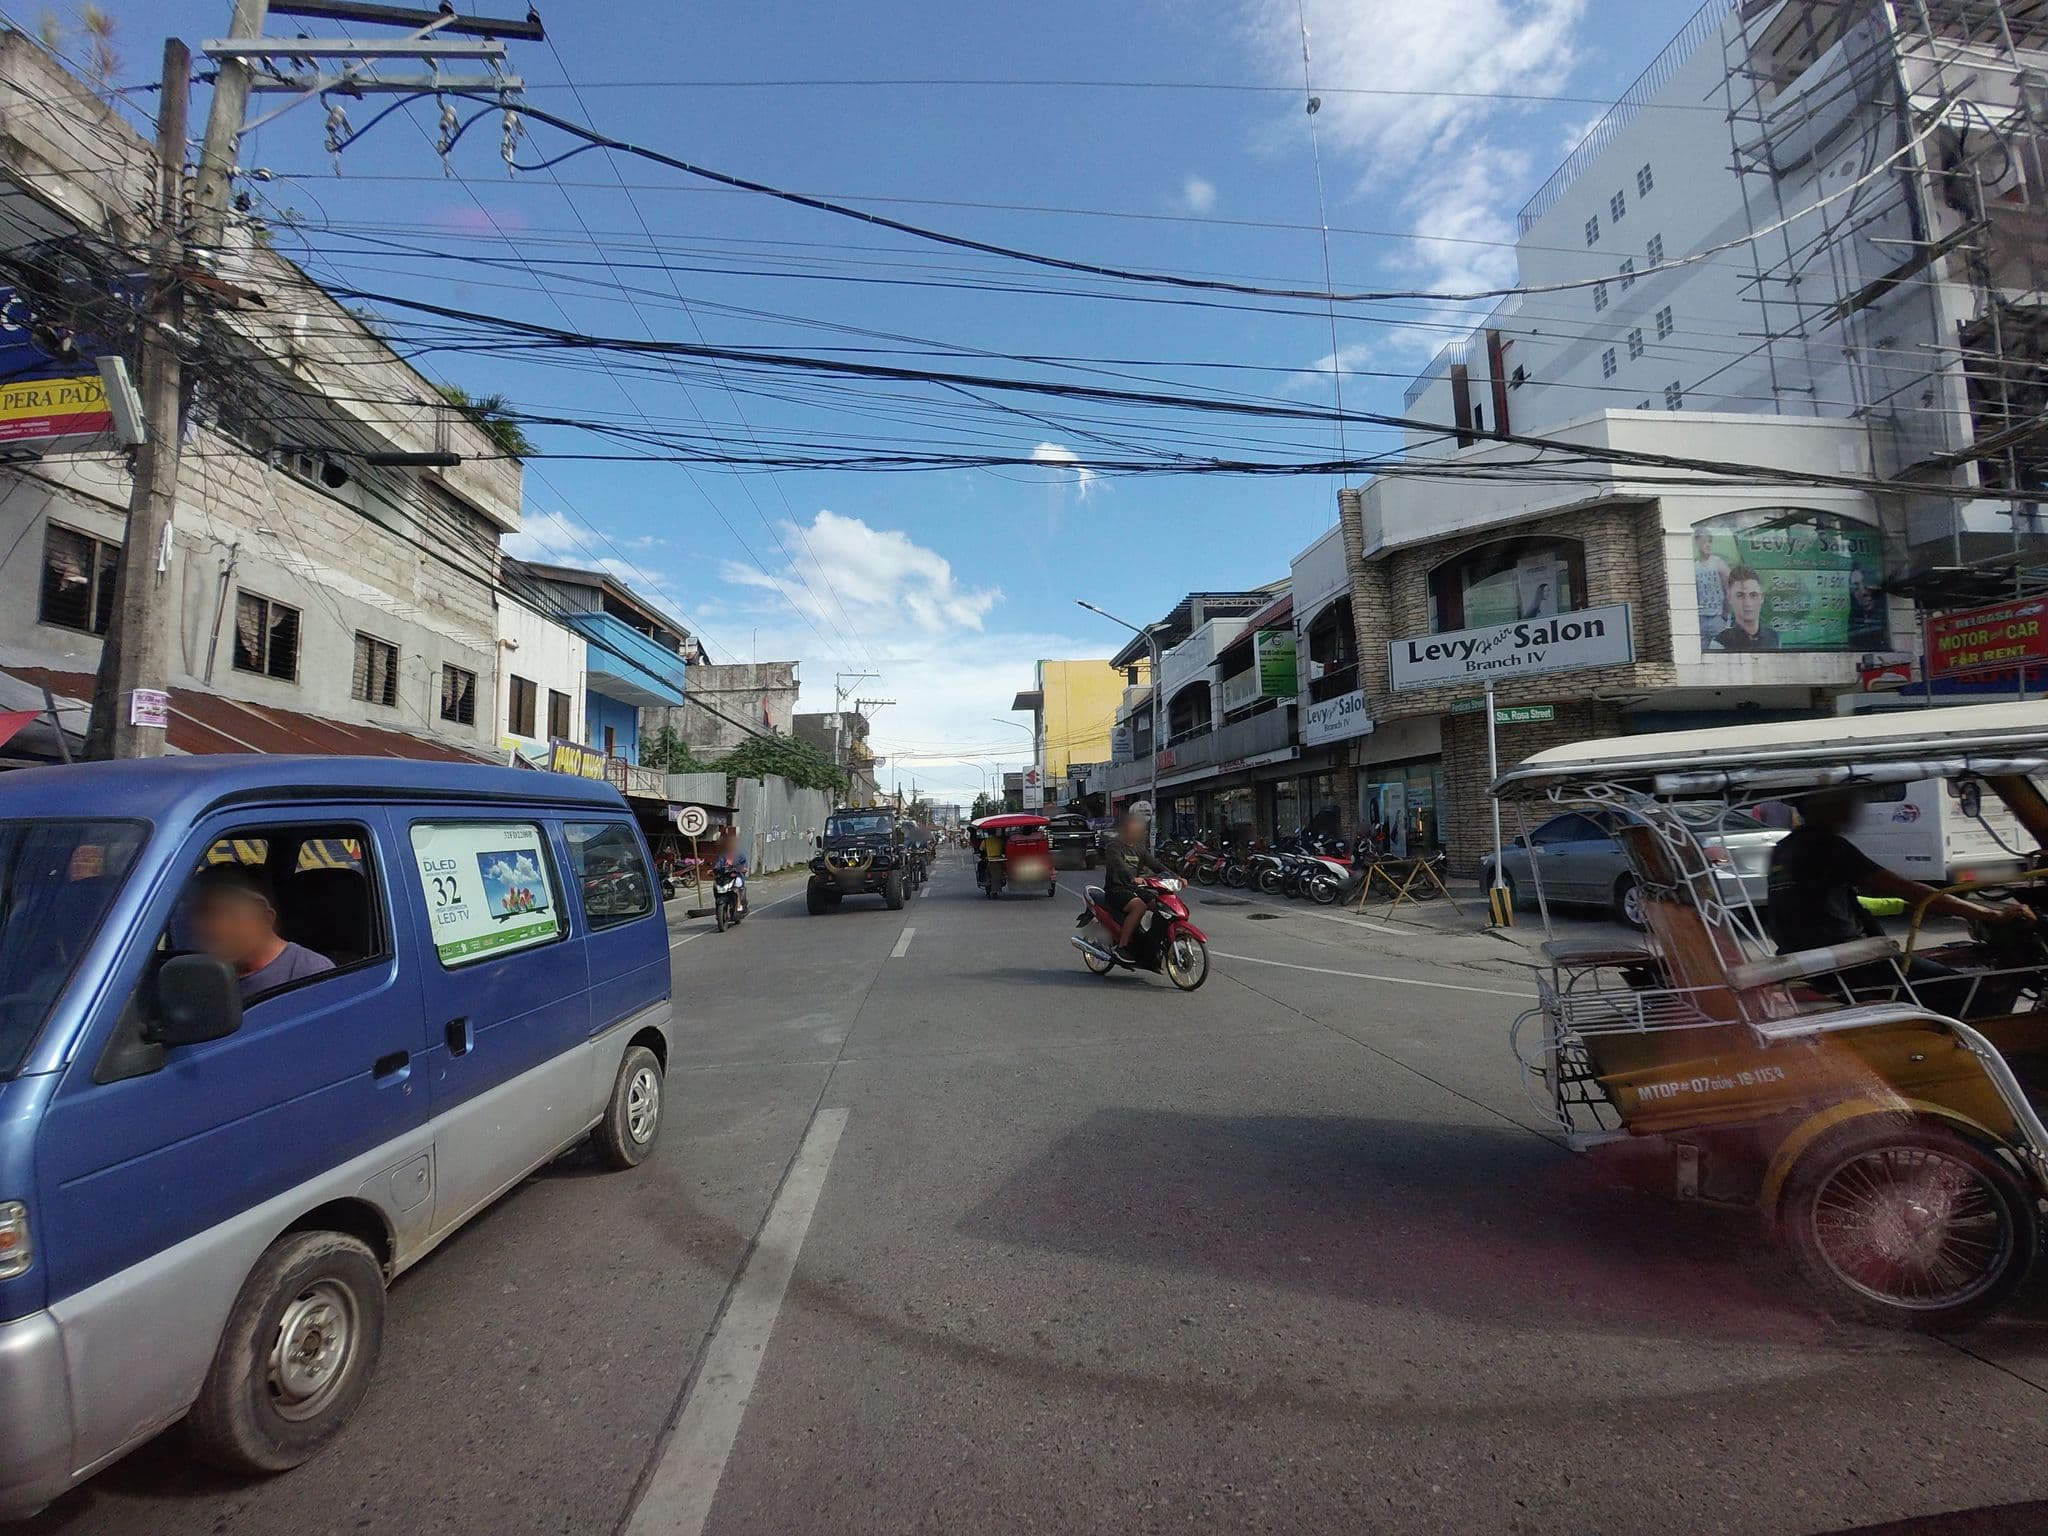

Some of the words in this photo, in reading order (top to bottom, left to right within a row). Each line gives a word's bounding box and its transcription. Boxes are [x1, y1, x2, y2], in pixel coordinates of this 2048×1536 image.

[3, 390, 53, 410] PERA
[59, 385, 106, 405] PAD
[1408, 639, 1477, 664] Levy
[1476, 628, 1513, 655] Hair
[1514, 619, 1605, 648] Salon
[1939, 630, 1989, 651] MOTOR
[2006, 621, 2039, 639] CAR
[1466, 654, 1521, 672] Branch
[1527, 651, 1546, 664] IV
[1983, 645, 2026, 660] RENT
[1306, 708, 1327, 724] Levy
[1496, 711, 1510, 721] Sta.
[1511, 710, 1530, 720] Rosa
[1530, 708, 1551, 719] Street
[423, 859, 456, 872] DLED
[432, 876, 462, 907] 32
[437, 911, 456, 925] LED
[457, 910, 469, 921] TV
